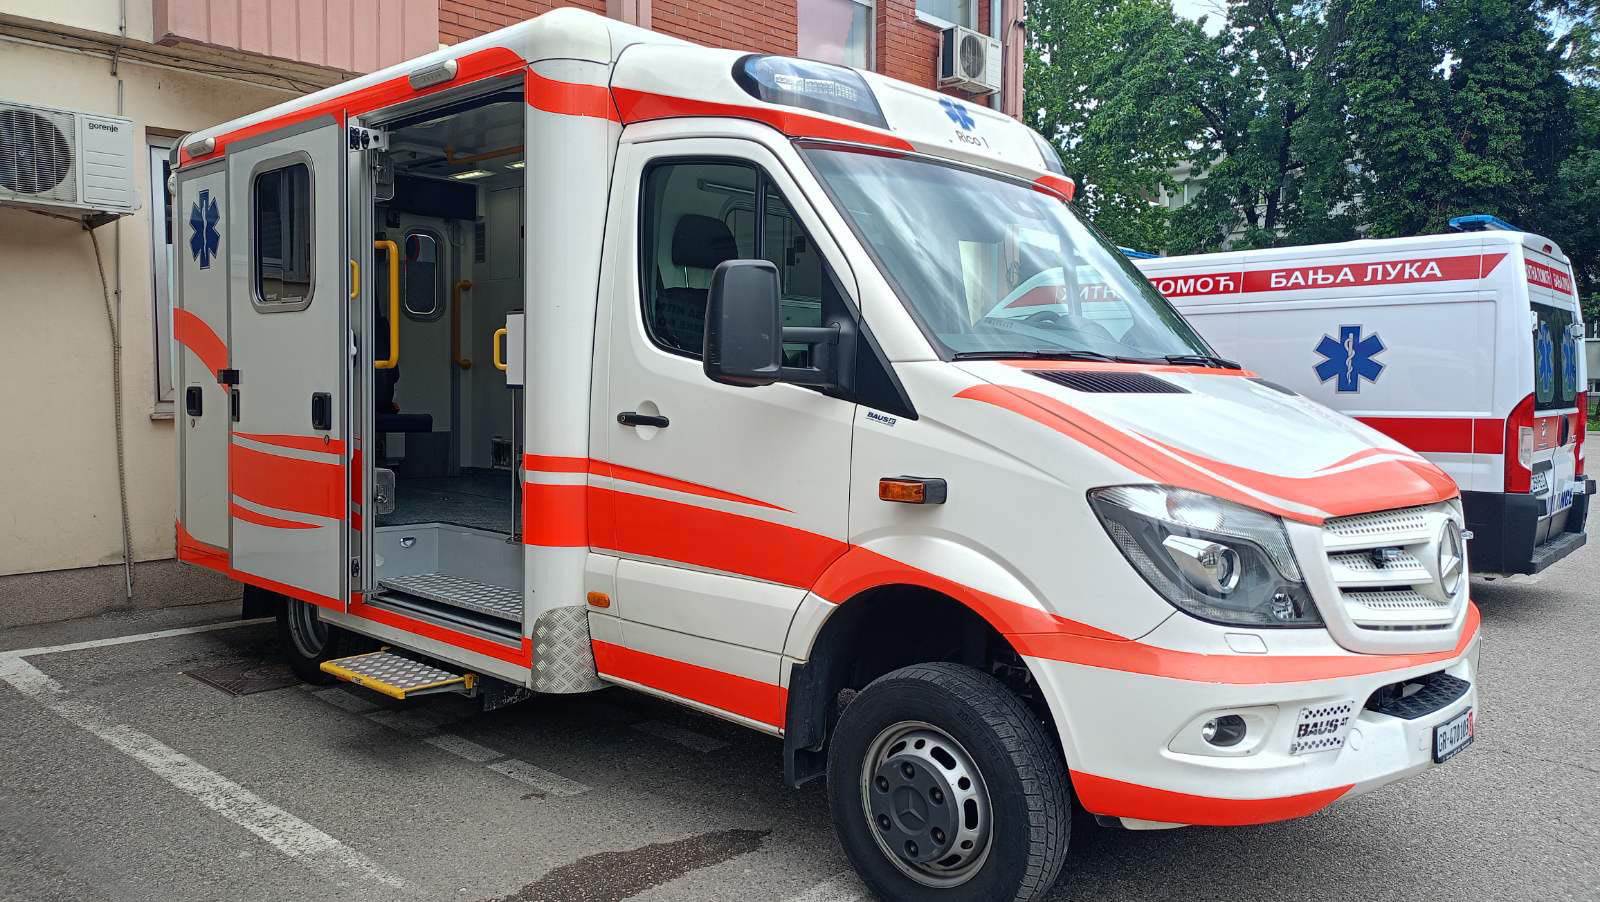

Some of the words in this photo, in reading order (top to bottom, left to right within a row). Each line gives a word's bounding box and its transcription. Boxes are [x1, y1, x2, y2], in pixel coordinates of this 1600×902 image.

[88, 122, 119, 133] gorenje
[1270, 267, 1355, 289] БАЊА
[1363, 261, 1442, 282] ЛУКА
[867, 411, 889, 423] BAUS
[1297, 718, 1340, 738] BAUS
